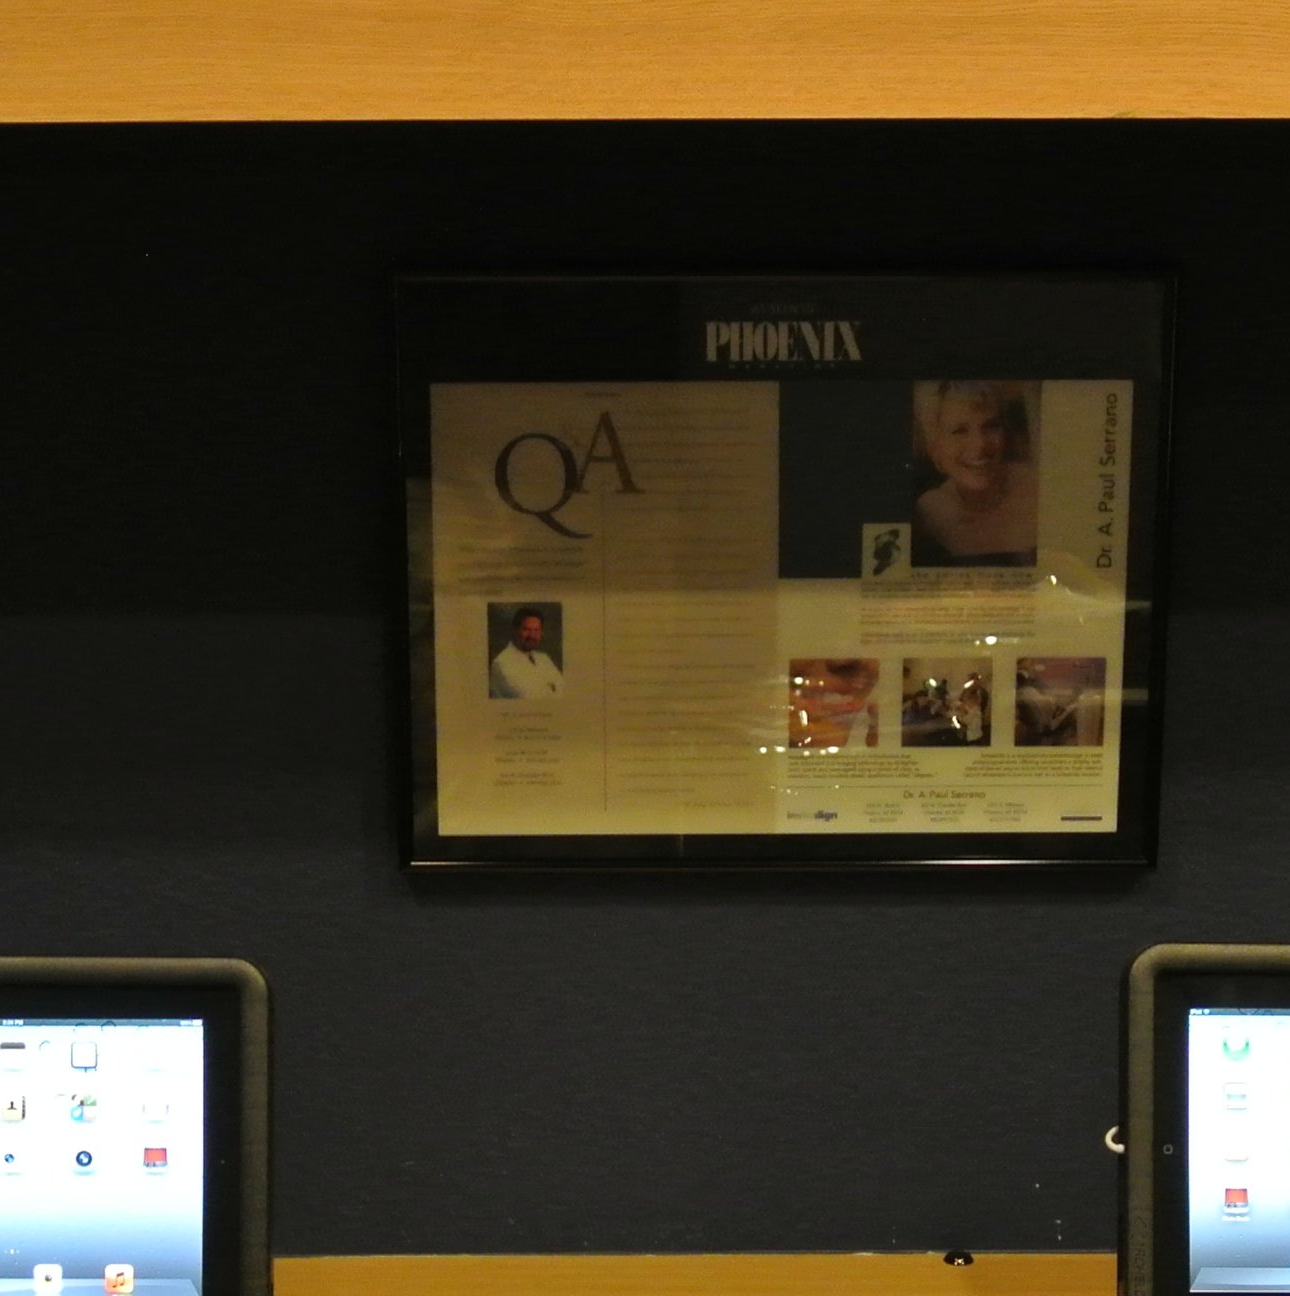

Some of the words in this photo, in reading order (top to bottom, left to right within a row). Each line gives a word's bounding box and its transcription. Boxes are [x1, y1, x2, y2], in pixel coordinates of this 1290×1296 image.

[705, 320, 863, 362] PHOENIX
[1100, 393, 1119, 466] Serrano
[1097, 473, 1116, 512] Paul
[929, 790, 948, 800] Paul
[950, 790, 986, 800] Serrano
[787, 809, 837, 823] invalign
